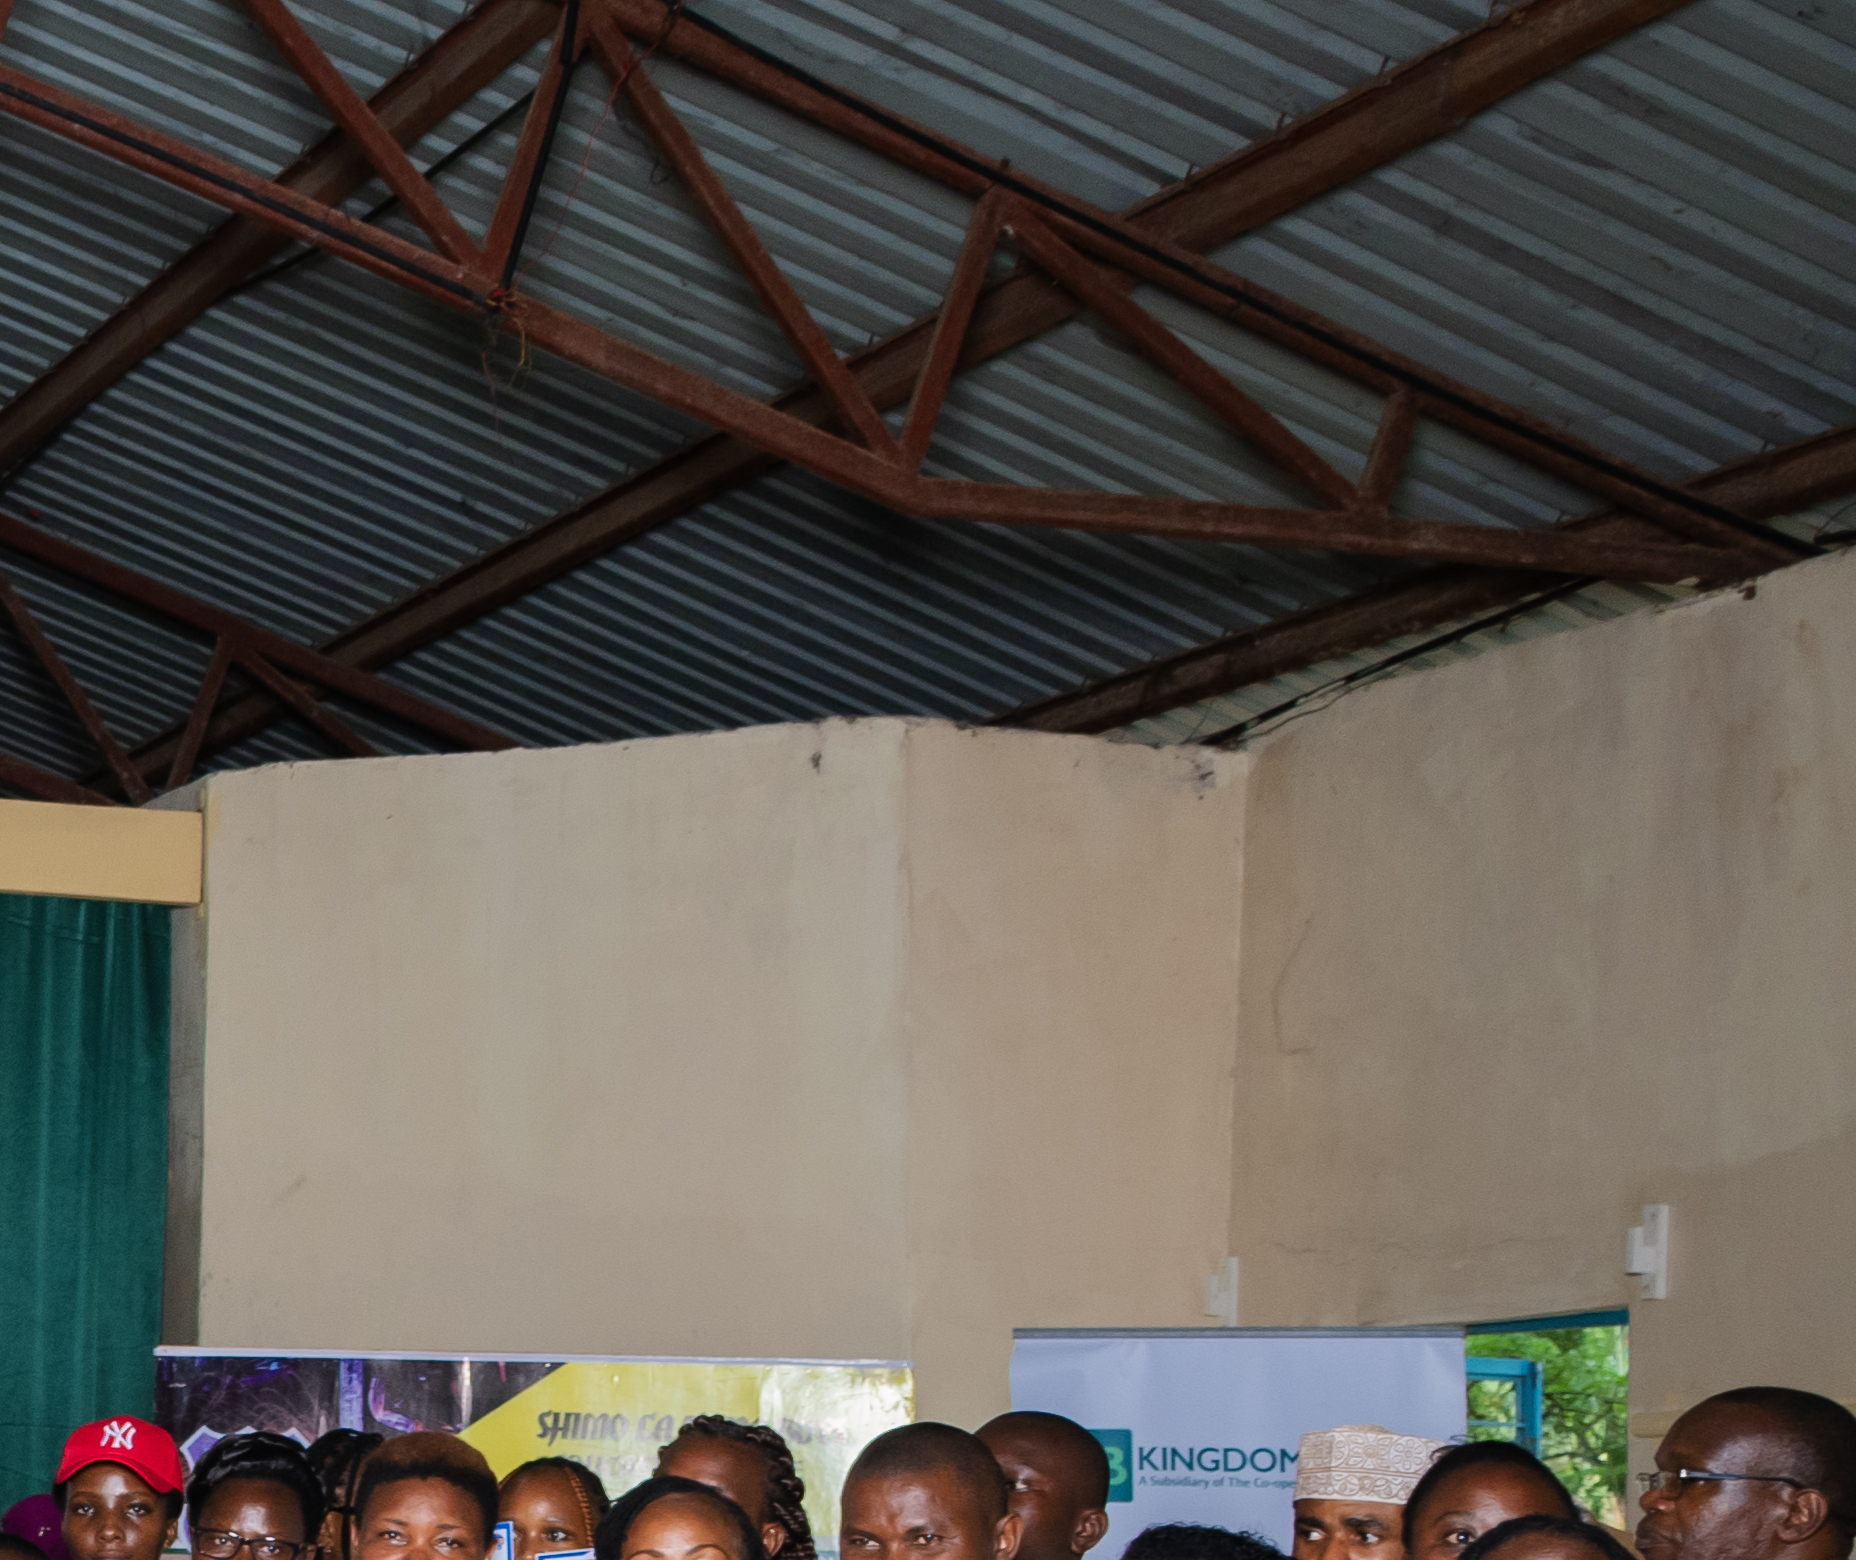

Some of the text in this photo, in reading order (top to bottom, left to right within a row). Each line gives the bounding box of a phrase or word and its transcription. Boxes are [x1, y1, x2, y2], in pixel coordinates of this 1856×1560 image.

[1150, 1477, 1209, 1489] Subsidiary
[1211, 1476, 1225, 1487] of
[1228, 1477, 1249, 1488] The
